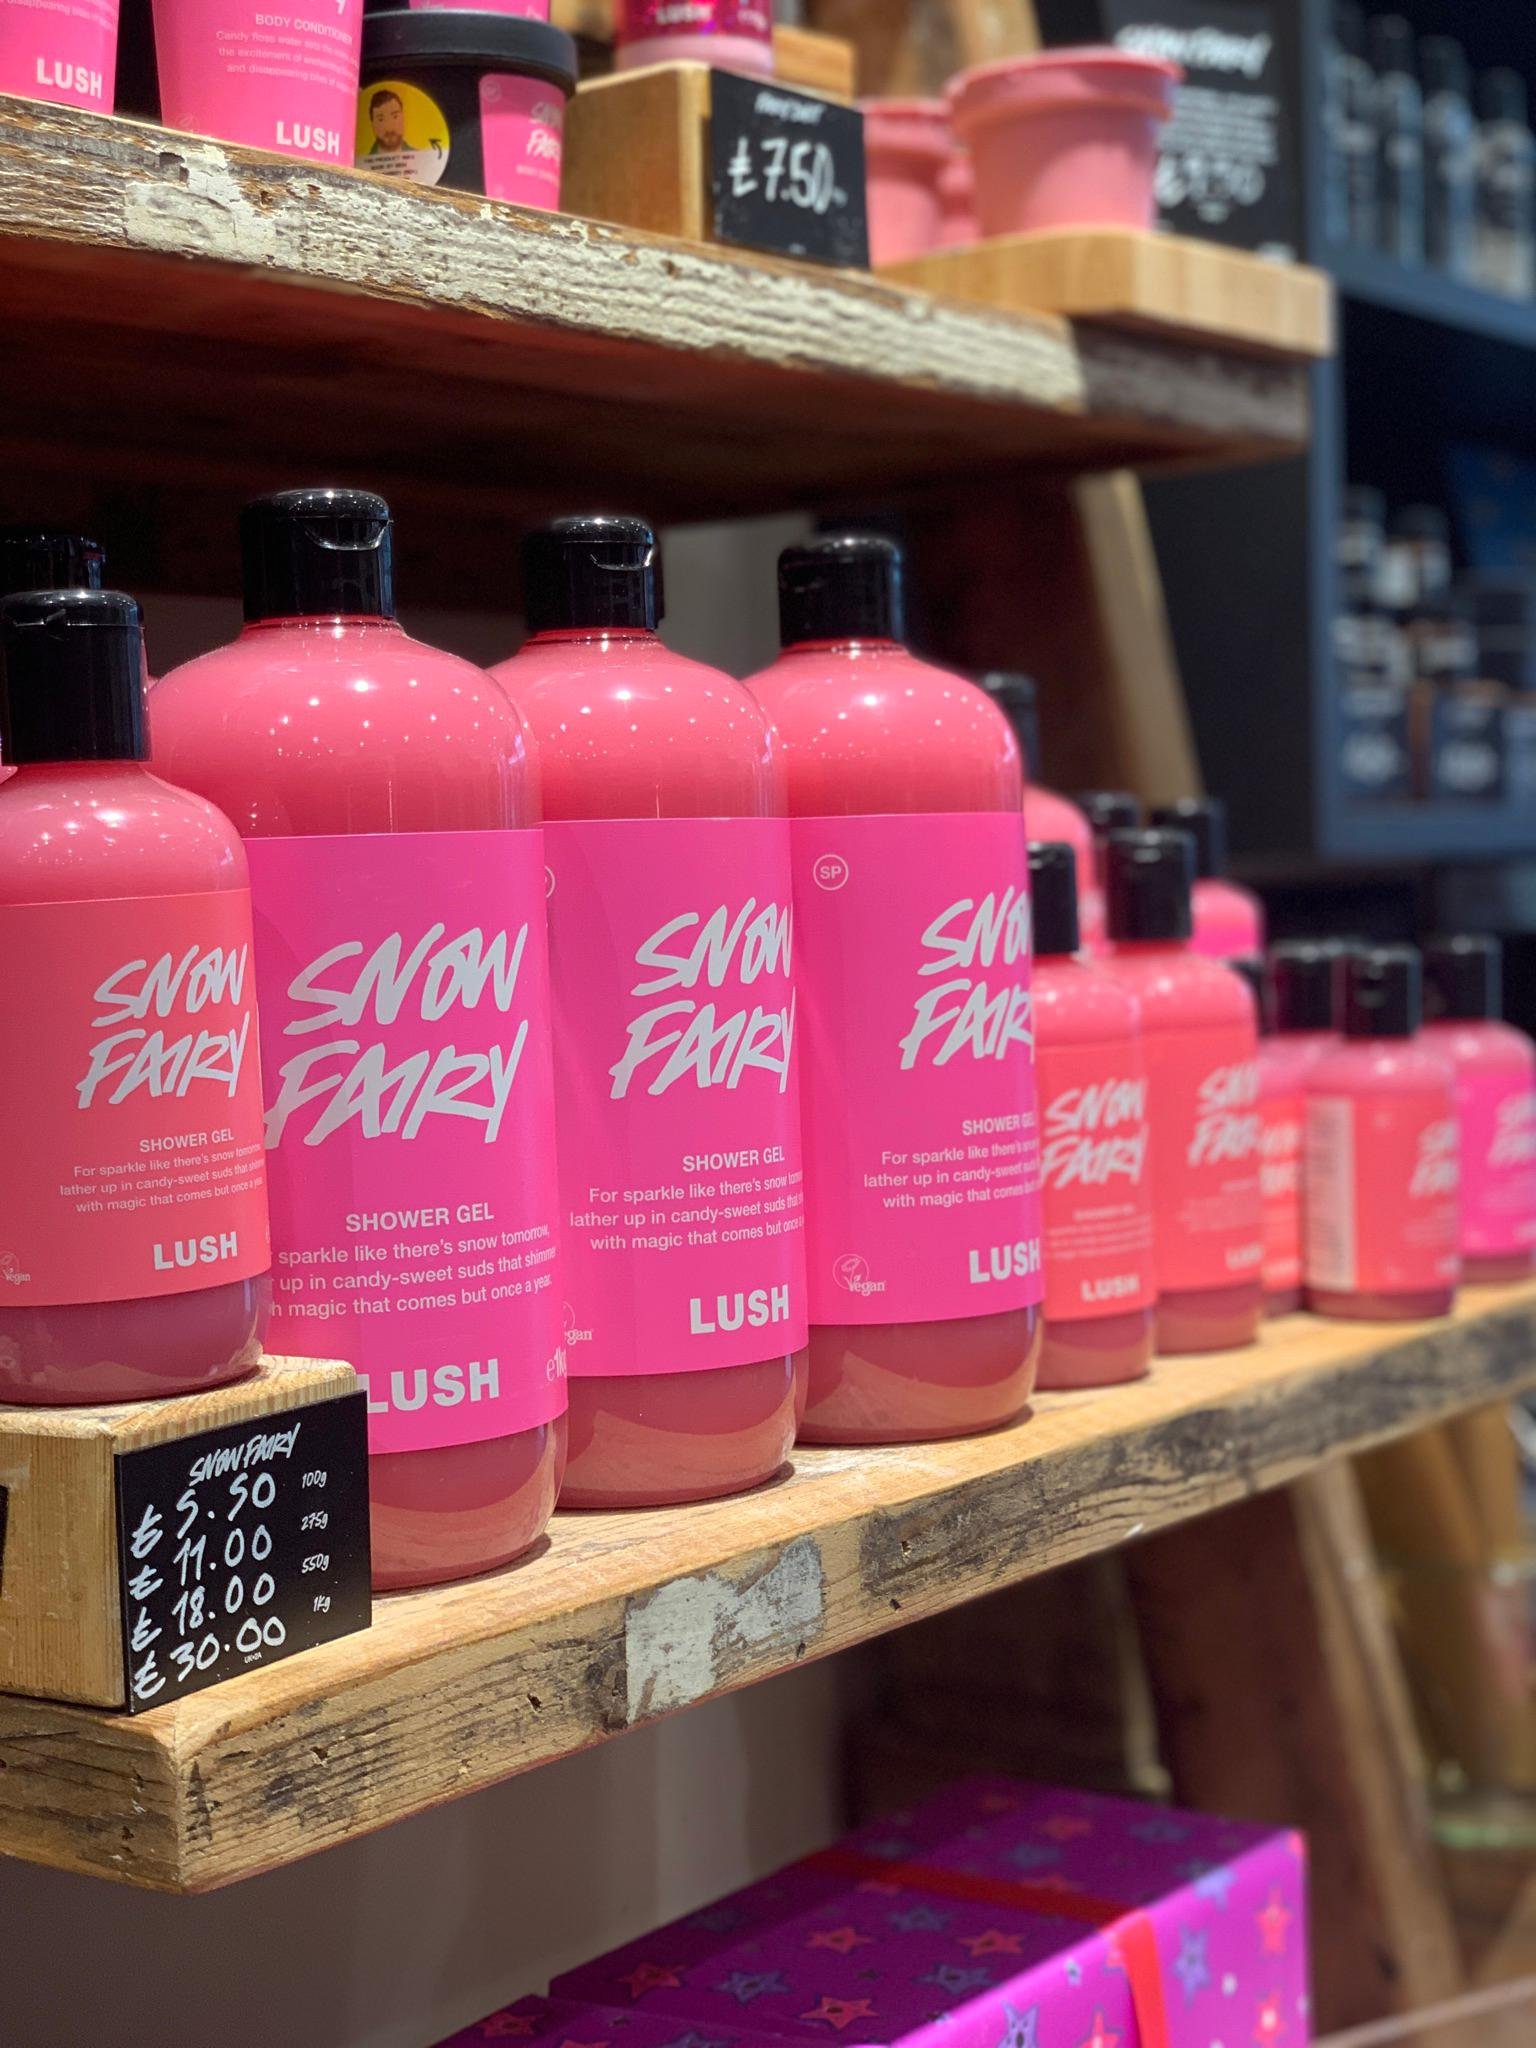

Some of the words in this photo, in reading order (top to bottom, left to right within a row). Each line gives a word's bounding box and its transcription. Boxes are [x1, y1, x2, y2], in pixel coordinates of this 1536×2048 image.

[255, 13, 292, 28] BODY
[36, 56, 102, 99] LUSH
[276, 120, 340, 156] LUSH
[819, 865, 842, 880] SP
[630, 897, 794, 997] SNOW
[91, 943, 248, 1027] SNOW
[283, 922, 528, 1036] SNOW
[898, 978, 1036, 1070] FAIR
[608, 985, 797, 1100] FAIRY
[75, 1011, 250, 1110] FAIRY
[263, 1019, 528, 1150] FAIRY
[139, 1132, 208, 1153] SHOWER
[211, 1127, 235, 1144] GEL
[962, 1113, 1020, 1136] SHOWER
[74, 1165, 96, 1177] For
[99, 1161, 146, 1177] sparkle
[150, 1158, 170, 1171] like
[173, 1153, 209, 1168] there's
[211, 1150, 235, 1163] snow
[682, 1149, 759, 1173] SHOWER
[763, 1145, 785, 1164] GEL
[881, 1151, 908, 1165] For
[912, 1147, 965, 1166] sparkle
[967, 1145, 989, 1159] like
[60, 1184, 97, 1196] lather
[100, 1183, 118, 1195] up
[121, 1181, 133, 1191] in
[136, 1171, 210, 1190] candy-sweet
[211, 1168, 233, 1180] suds
[234, 1163, 248, 1176] that
[589, 1187, 618, 1204] For
[623, 1185, 685, 1206] sparkle
[689, 1183, 716, 1199] like
[720, 1177, 762, 1196] there's
[764, 1174, 788, 1191] snow
[863, 1173, 909, 1188] lather
[913, 1173, 932, 1188] up
[936, 1169, 949, 1183] in
[953, 1162, 1022, 1183] candy-sweet
[76, 1200, 103, 1213] with
[107, 1197, 147, 1211] magic
[150, 1193, 173, 1206] that
[176, 1188, 212, 1203] comes
[214, 1184, 230, 1197] but
[231, 1182, 248, 1194] once
[569, 1211, 619, 1227] lather
[624, 1212, 646, 1229] up
[650, 1209, 666, 1225] in
[671, 1201, 761, 1224] candy-sweet
[764, 1196, 786, 1214] suds
[882, 1193, 915, 1208] with
[920, 1190, 964, 1208] magic
[967, 1187, 991, 1202] that
[345, 1207, 450, 1233] SHOWER
[456, 1202, 495, 1224] GEL
[590, 1235, 626, 1250] with
[632, 1232, 683, 1251] magic
[687, 1229, 718, 1246] that
[721, 1225, 764, 1243] comes
[766, 1221, 782, 1237] but
[783, 1216, 798, 1233] once
[153, 1231, 238, 1271] LUSH
[278, 1246, 349, 1268] sparkle
[354, 1245, 387, 1262] like
[393, 1238, 454, 1260] there's
[458, 1235, 498, 1253] snow
[969, 1238, 1041, 1284] LUSH
[279, 1277, 303, 1294] up
[309, 1273, 326, 1290] in
[332, 1265, 453, 1290] candy-sweet
[458, 1259, 495, 1279] suds
[498, 1254, 522, 1273] that
[845, 1275, 887, 1297] Vegan
[288, 1299, 347, 1320] magic
[352, 1296, 391, 1315] that
[396, 1292, 456, 1312] comes
[462, 1286, 487, 1305] but
[491, 1282, 522, 1300] once
[525, 1280, 532, 1294] a
[689, 1284, 790, 1335] LUSH
[565, 1328, 593, 1346] gan
[357, 1358, 500, 1414] LUSH
[189, 1443, 245, 1487] SNOW
[243, 1422, 301, 1469] FAIRY
[301, 1470, 327, 1489] 100g
[301, 1510, 328, 1531] 275g
[301, 1553, 330, 1574] 550g
